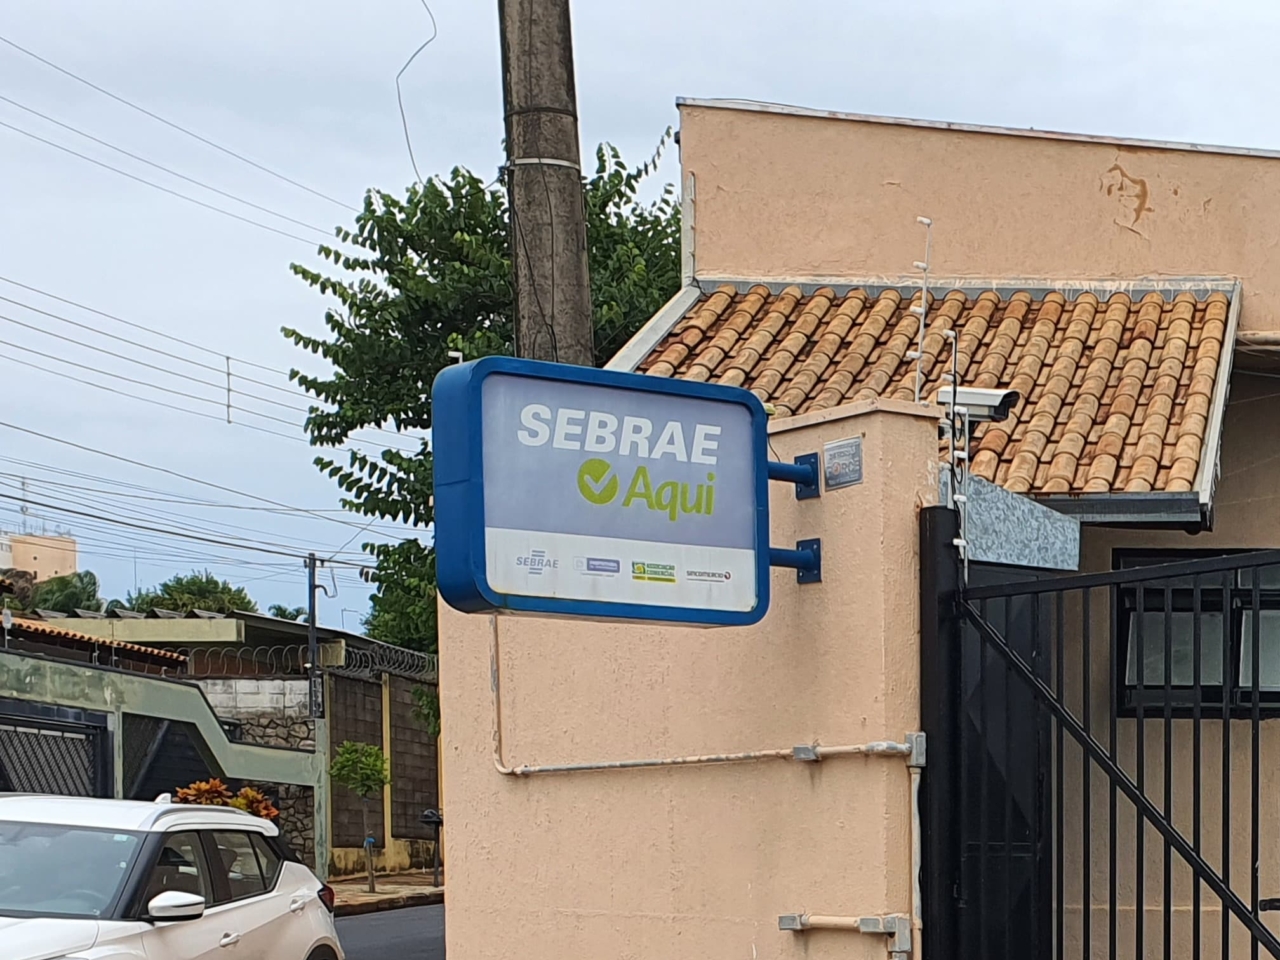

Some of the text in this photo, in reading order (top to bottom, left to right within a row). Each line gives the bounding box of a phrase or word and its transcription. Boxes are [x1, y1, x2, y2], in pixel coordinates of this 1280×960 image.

[517, 403, 722, 465] SEBRAE
[622, 466, 716, 521] Aqui
[516, 556, 559, 569] SEBRAE
